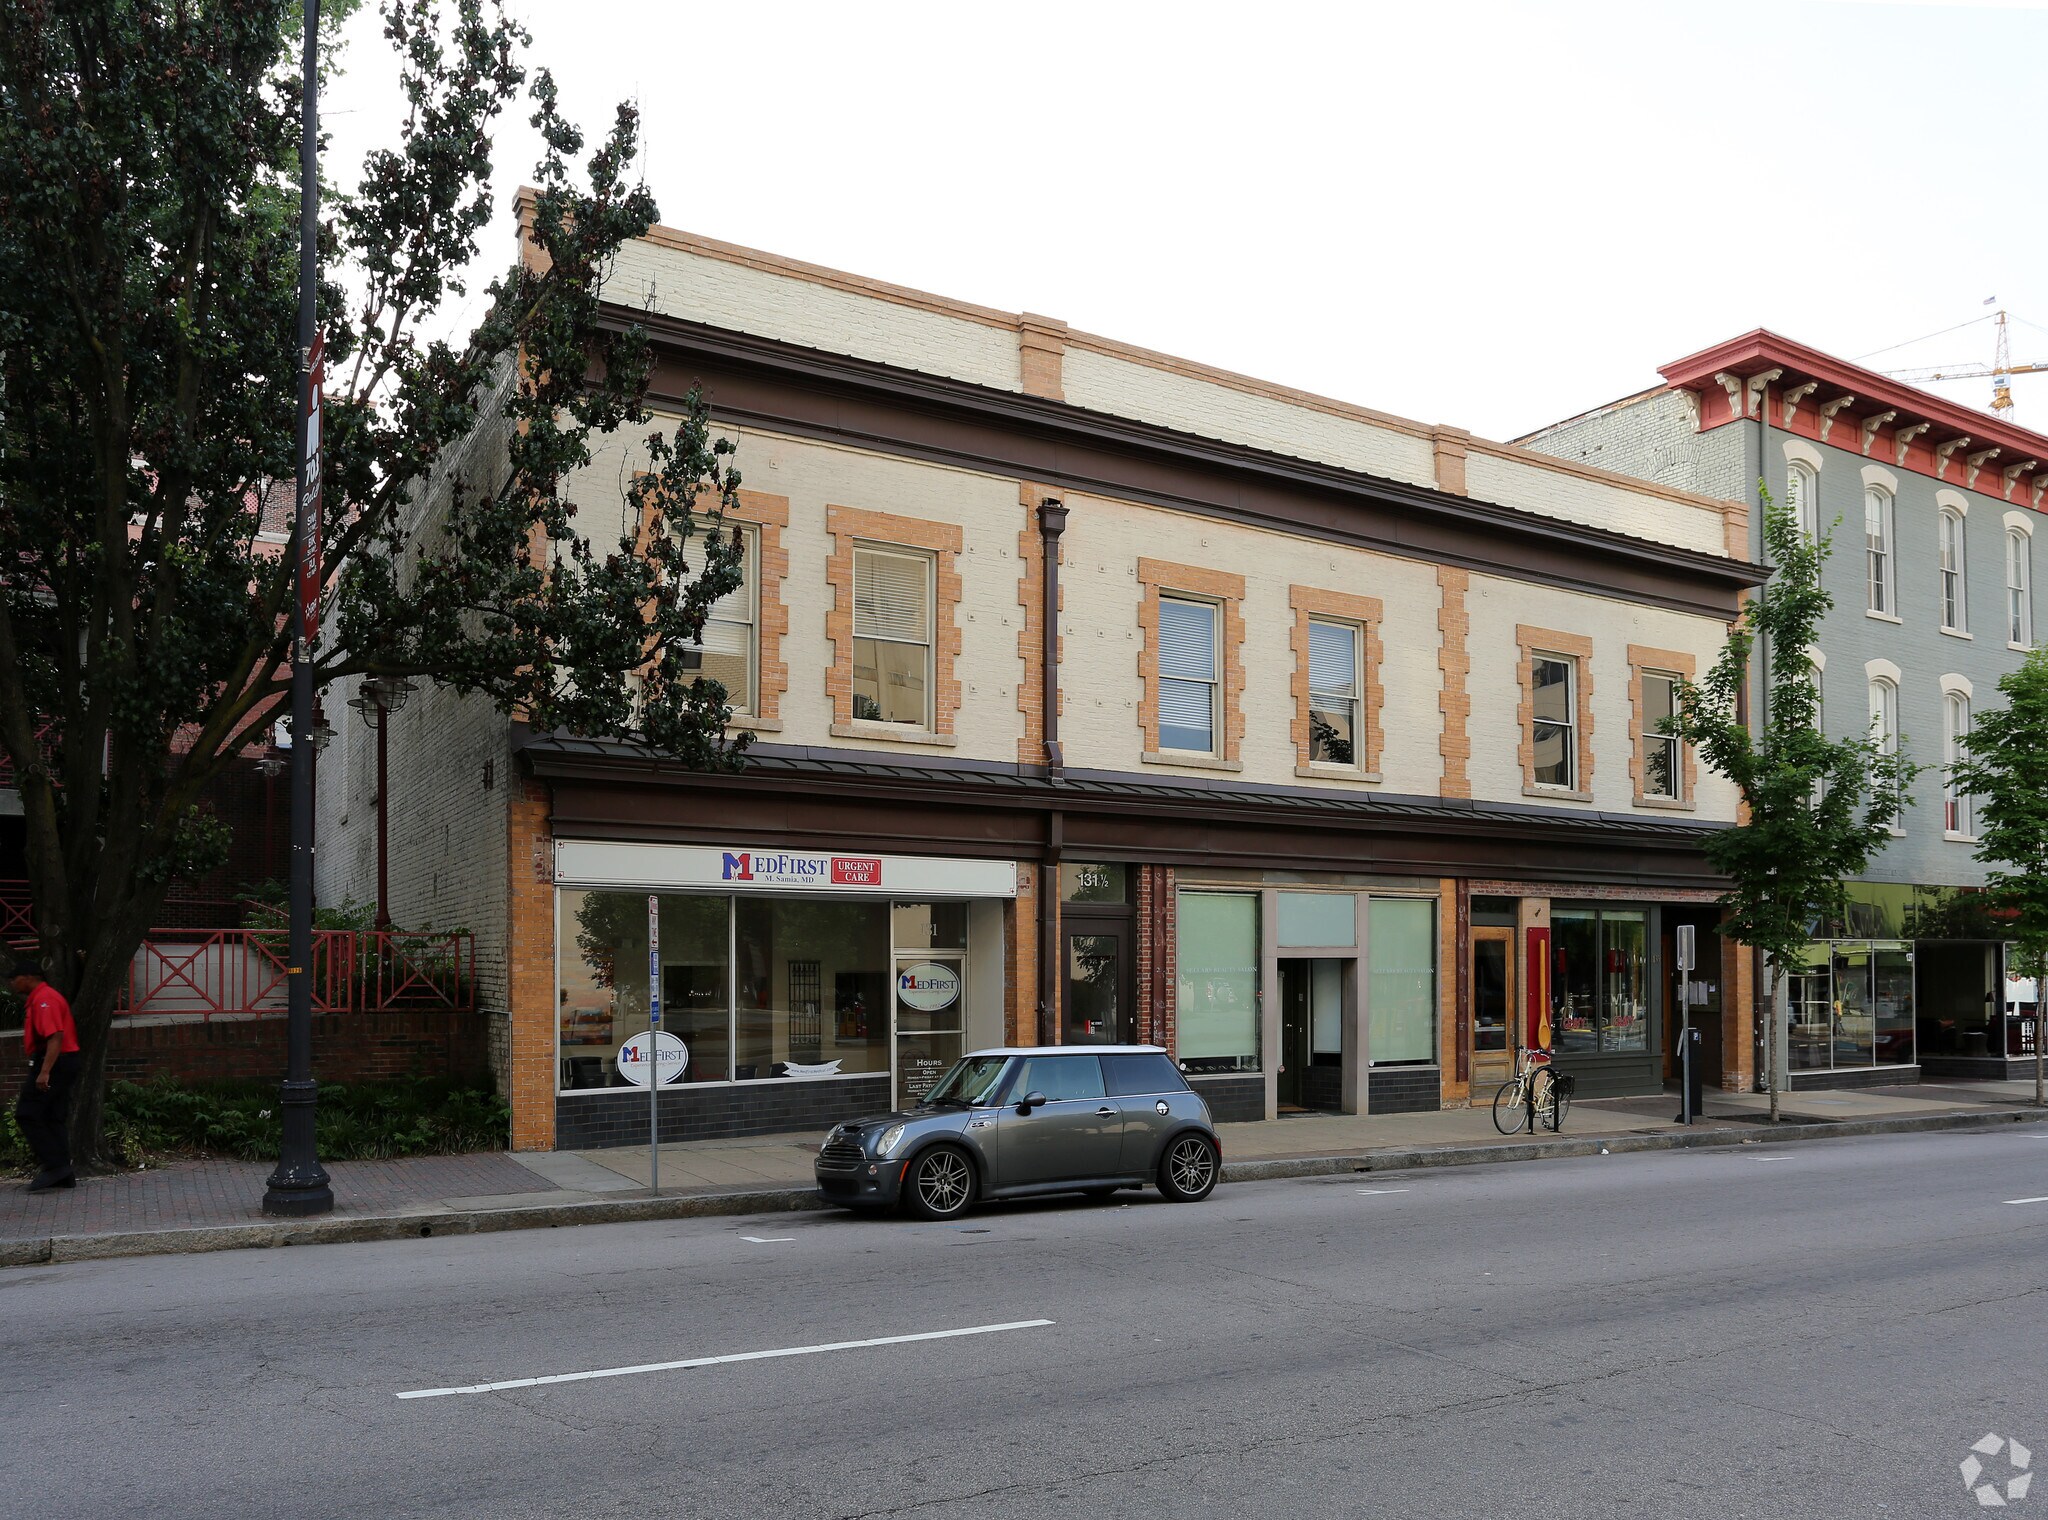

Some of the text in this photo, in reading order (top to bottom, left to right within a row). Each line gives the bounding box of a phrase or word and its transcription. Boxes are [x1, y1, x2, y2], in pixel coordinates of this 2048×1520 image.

[838, 861, 875, 872] URGENT
[776, 876, 800, 884] Samia,
[845, 872, 870, 882] CARE
[1078, 873, 1098, 887] 131
[916, 1059, 943, 1067] HOURS
